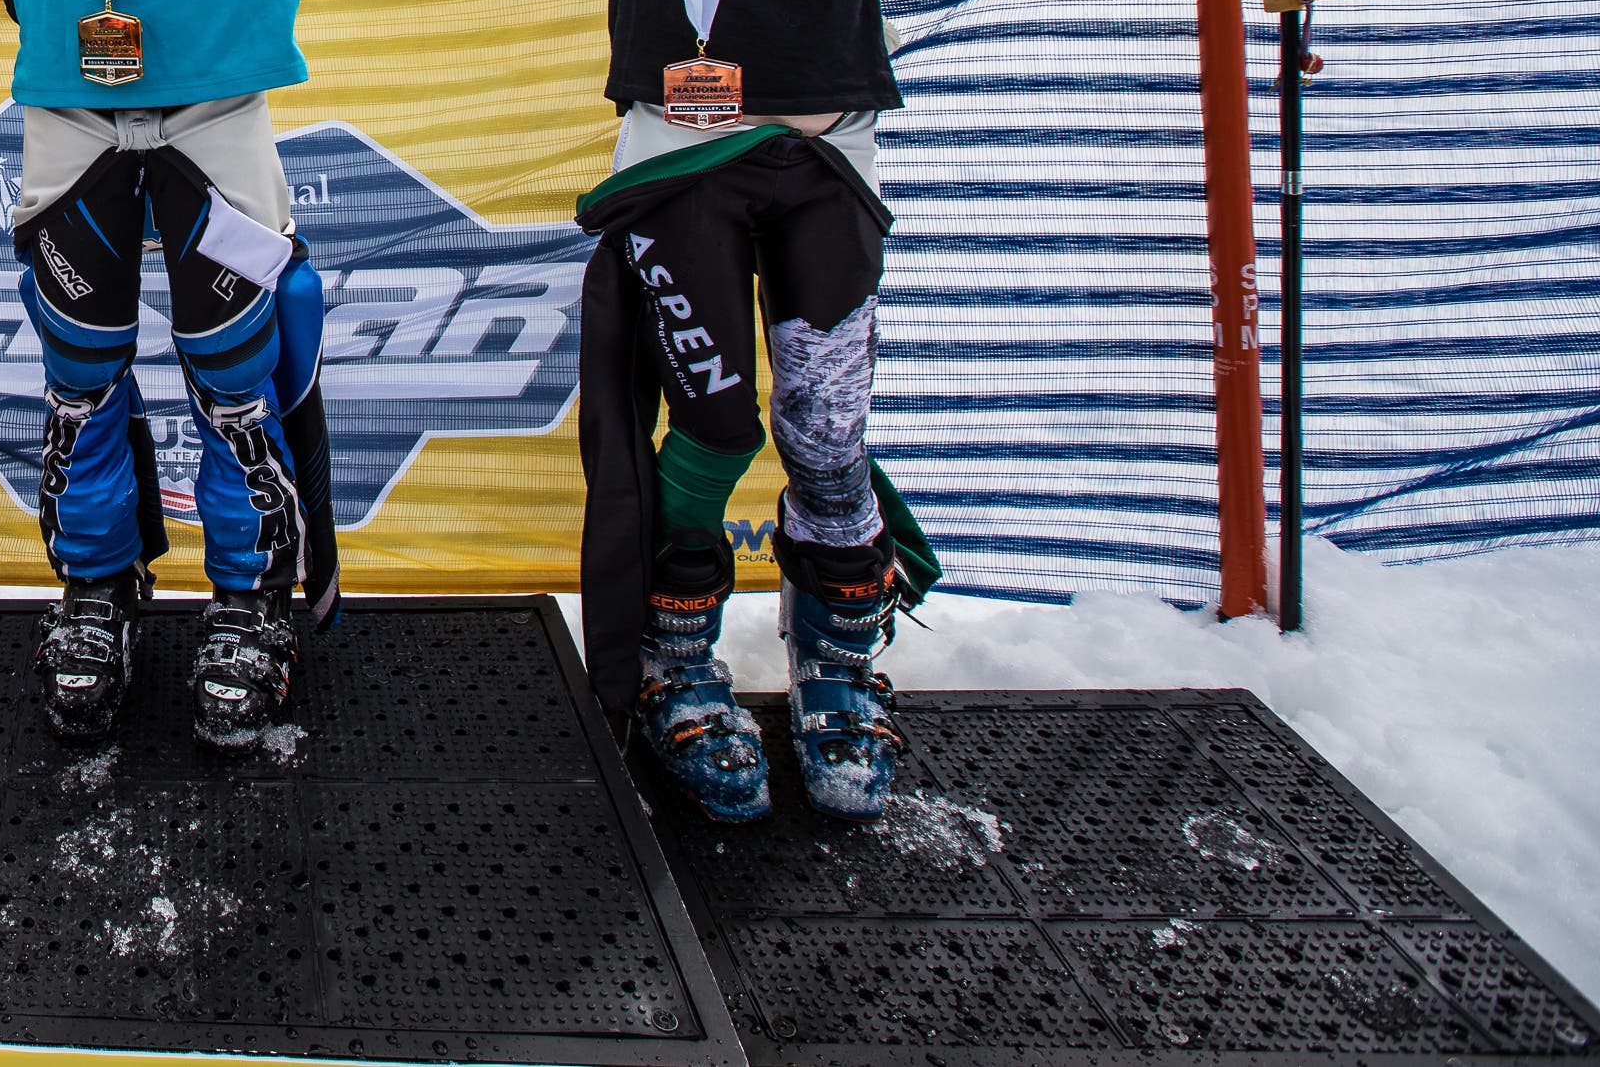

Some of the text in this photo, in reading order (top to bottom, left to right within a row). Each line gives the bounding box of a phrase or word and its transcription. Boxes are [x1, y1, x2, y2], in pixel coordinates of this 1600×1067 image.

[628, 232, 743, 395] ASPEN
[676, 371, 697, 399] CLUB
[175, 451, 201, 461] TEA
[737, 554, 768, 562] OUR
[650, 594, 717, 612] ECNICA
